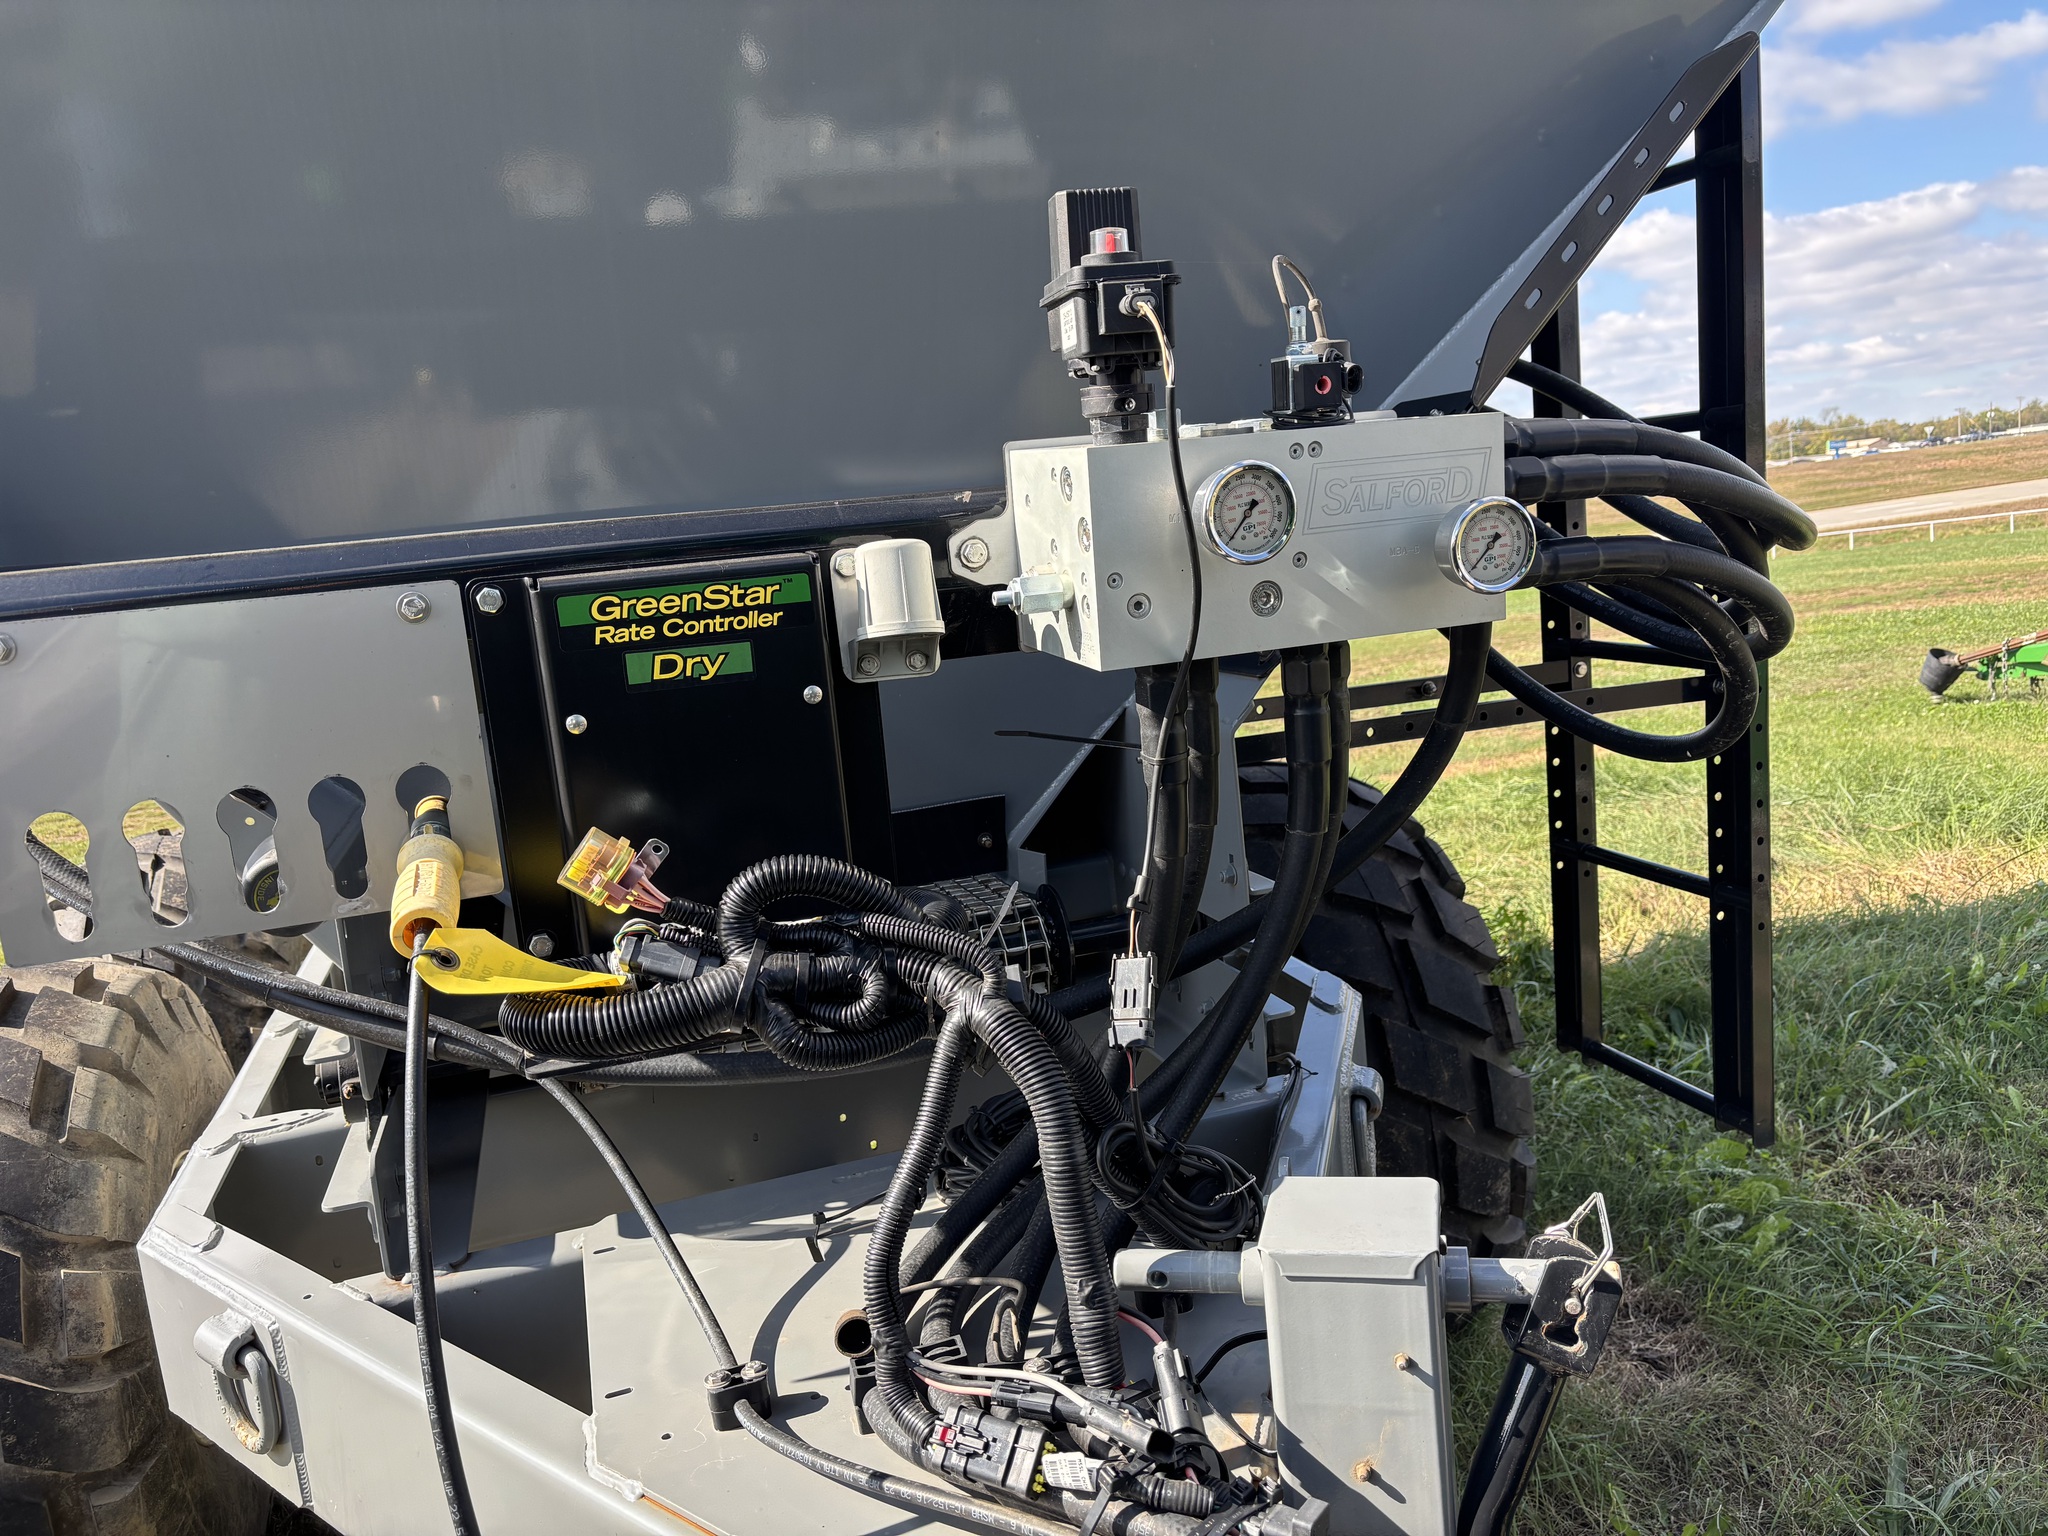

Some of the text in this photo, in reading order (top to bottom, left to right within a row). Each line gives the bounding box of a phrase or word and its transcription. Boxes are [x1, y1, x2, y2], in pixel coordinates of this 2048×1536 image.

[1321, 466, 1473, 516] SALFORD
[1243, 523, 1256, 532] GPI
[590, 583, 780, 622] GreenStar
[594, 610, 784, 645] Rate Controller
[653, 652, 726, 681] Dry
[259, 873, 277, 902] INSIDE
[353, 1000, 379, 1013] ITALY
[813, 1459, 841, 1476] ITALY
[841, 1469, 855, 1482] IN
[857, 1474, 881, 1490] MADE
[882, 1484, 896, 1495] 23
[914, 1491, 967, 1515] IC-152/16
[968, 1507, 997, 1525] MSHA
[1019, 1523, 1035, 1536] DN
